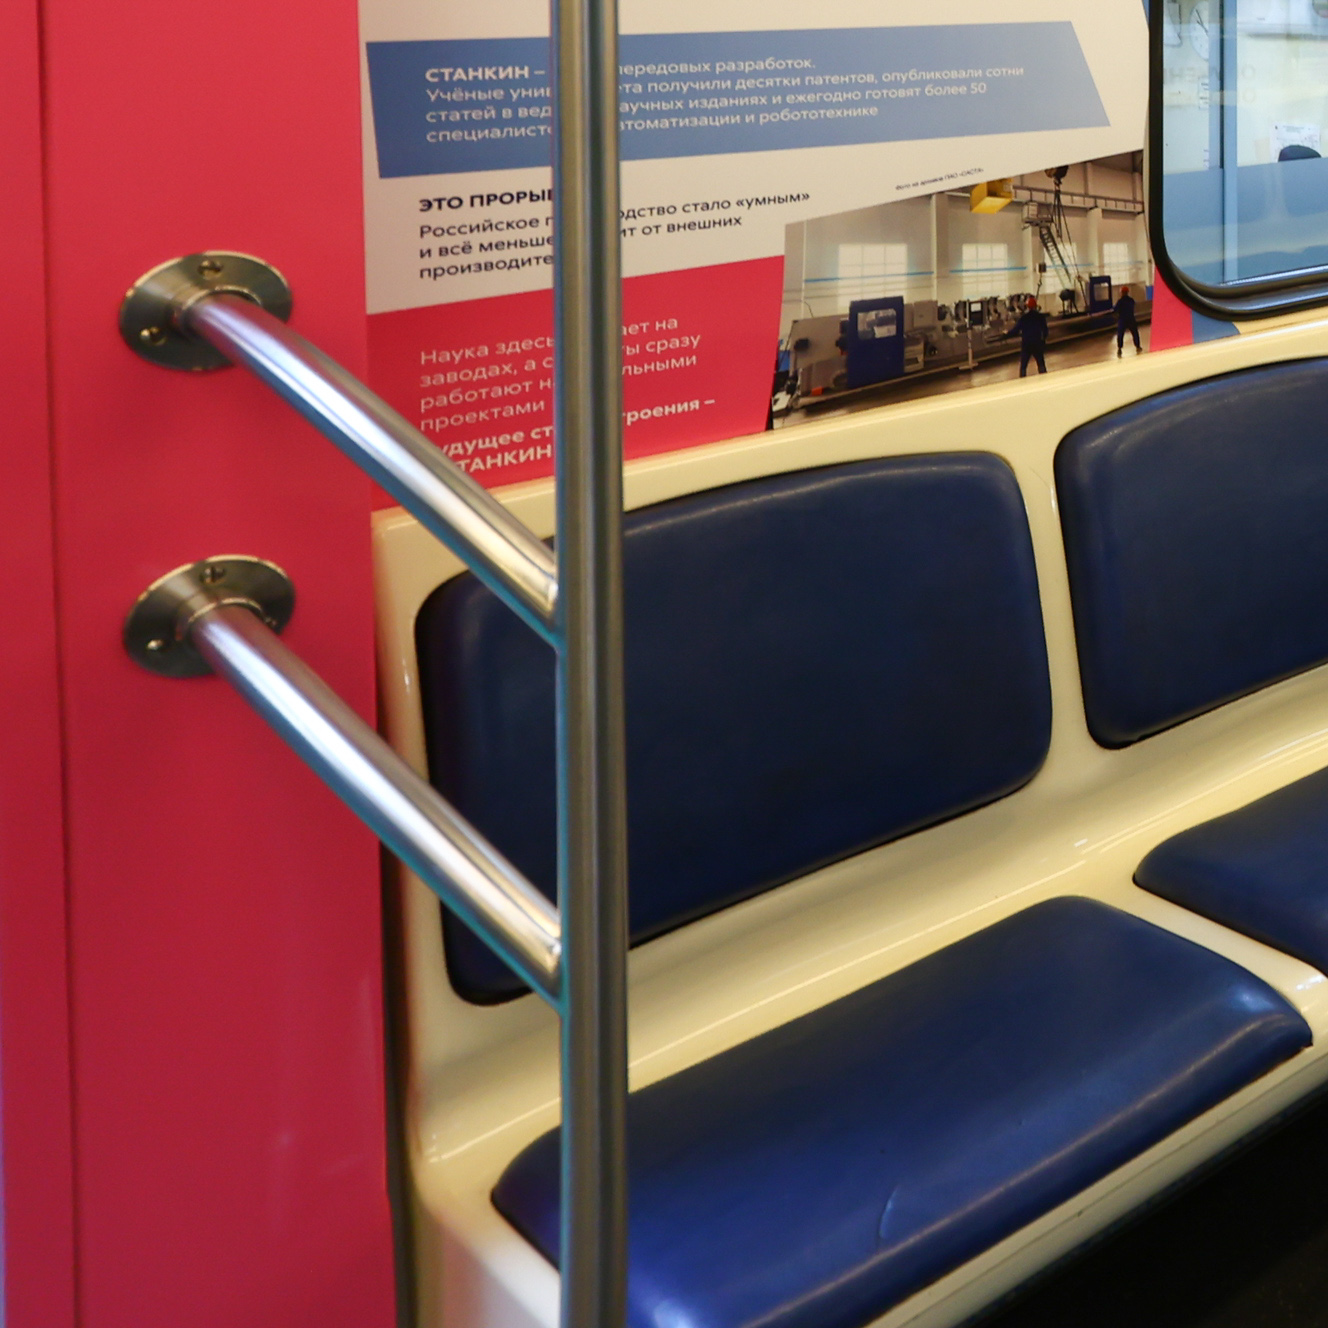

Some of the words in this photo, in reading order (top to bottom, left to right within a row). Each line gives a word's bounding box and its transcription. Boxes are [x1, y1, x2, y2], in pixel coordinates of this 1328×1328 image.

[425, 66, 530, 83] СТАНКИН
[716, 57, 816, 77] разработок.
[425, 87, 505, 104] Учёные
[647, 78, 732, 96] получили
[735, 74, 801, 92] десятки
[804, 73, 878, 88] патентов,
[882, 67, 983, 85] опубликовали
[985, 65, 1025, 79] сотни
[425, 106, 496, 124] статей
[501, 108, 513, 120] в
[688, 93, 768, 110] изданиях
[771, 93, 782, 105] и
[785, 89, 862, 106] ежегодно
[865, 86, 922, 101] готовят
[924, 82, 968, 96] более
[970, 81, 988, 95] 50
[745, 112, 756, 125] и
[759, 104, 879, 125] робототехнике
[418, 195, 463, 214] ЭТО
[419, 216, 541, 240] Российское
[681, 198, 732, 214] стало
[735, 191, 811, 211] «умным»
[419, 245, 433, 260] и
[438, 237, 473, 258] всё
[641, 223, 663, 236] от
[667, 215, 743, 234] внешних
[420, 344, 489, 366] Наука
[655, 318, 679, 331] на
[420, 360, 518, 388] заводах,
[524, 359, 537, 372] а
[645, 334, 701, 354] сразу
[420, 379, 533, 413] работают
[420, 400, 546, 433] проектами
